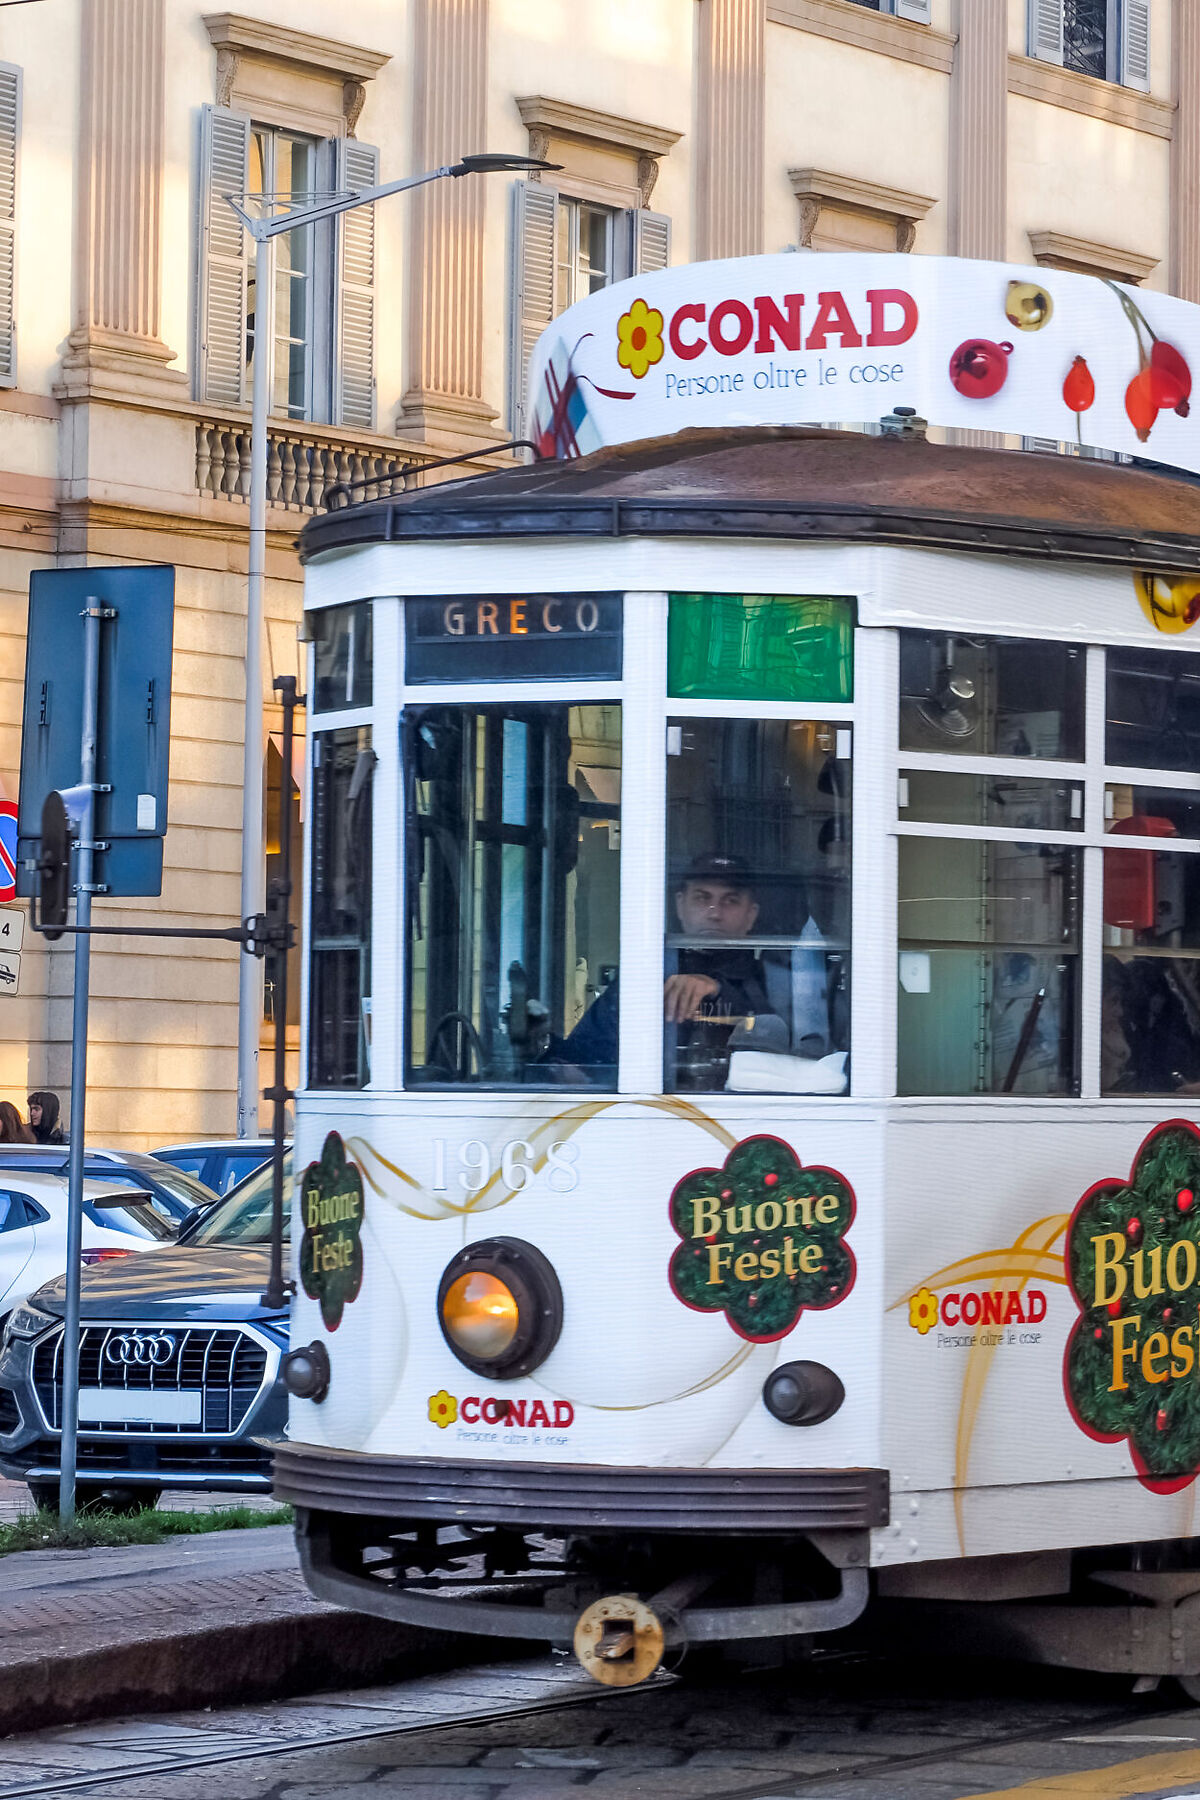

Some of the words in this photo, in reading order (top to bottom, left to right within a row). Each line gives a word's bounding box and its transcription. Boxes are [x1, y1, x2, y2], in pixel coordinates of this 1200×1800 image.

[669, 288, 919, 360] CONAD
[665, 372, 744, 398] Persone
[753, 361, 807, 389] oltre
[818, 358, 837, 386] le
[849, 362, 904, 384] cose
[443, 599, 599, 636] GRECO
[432, 1138, 580, 1192] 1968
[306, 1189, 360, 1229] Buone
[690, 1194, 840, 1240] Buone
[311, 1231, 354, 1273] Feste
[704, 1238, 824, 1285] Feste
[941, 1290, 1047, 1327] CONAD
[937, 1332, 977, 1348] Persone
[460, 1396, 575, 1428] CONAD
